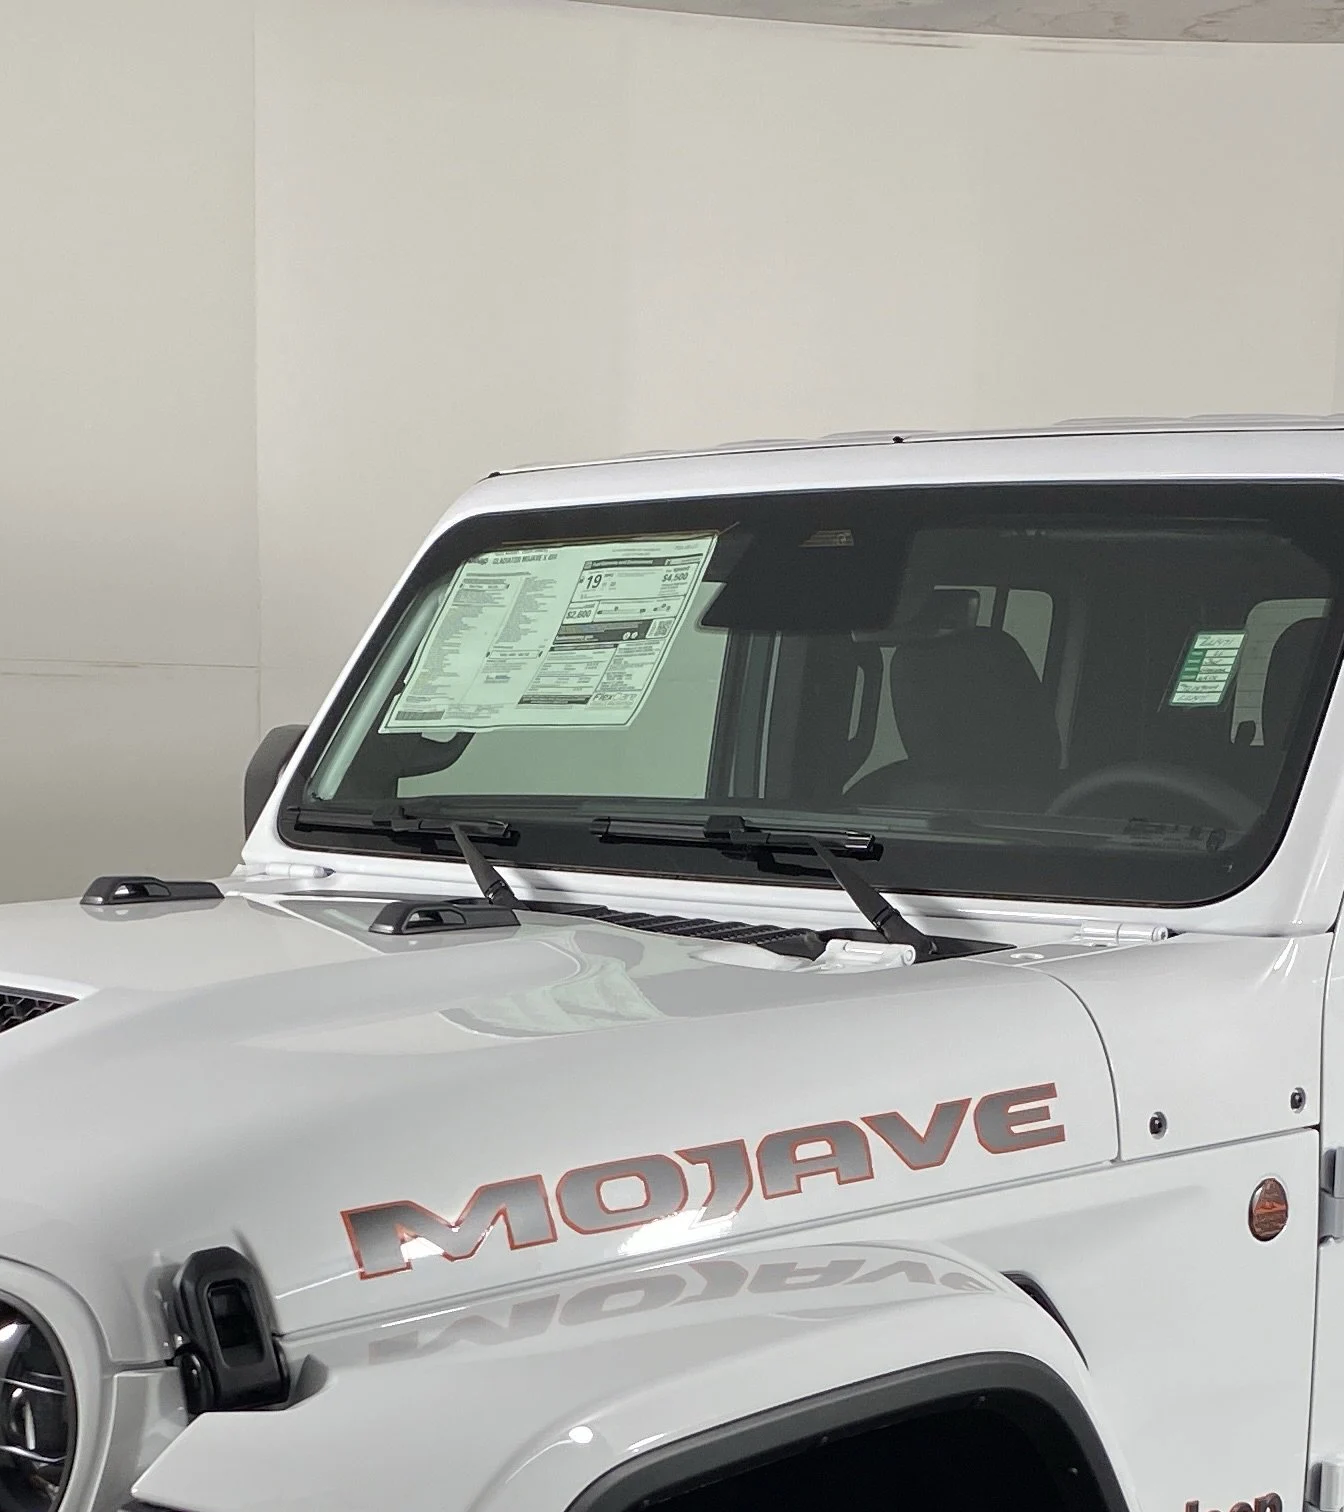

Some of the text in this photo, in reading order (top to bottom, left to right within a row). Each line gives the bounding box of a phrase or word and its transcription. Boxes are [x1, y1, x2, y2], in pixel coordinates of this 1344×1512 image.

[586, 574, 602, 590] 19
[661, 572, 689, 582] $4,500
[340, 1082, 1066, 1280] MOJAVE
